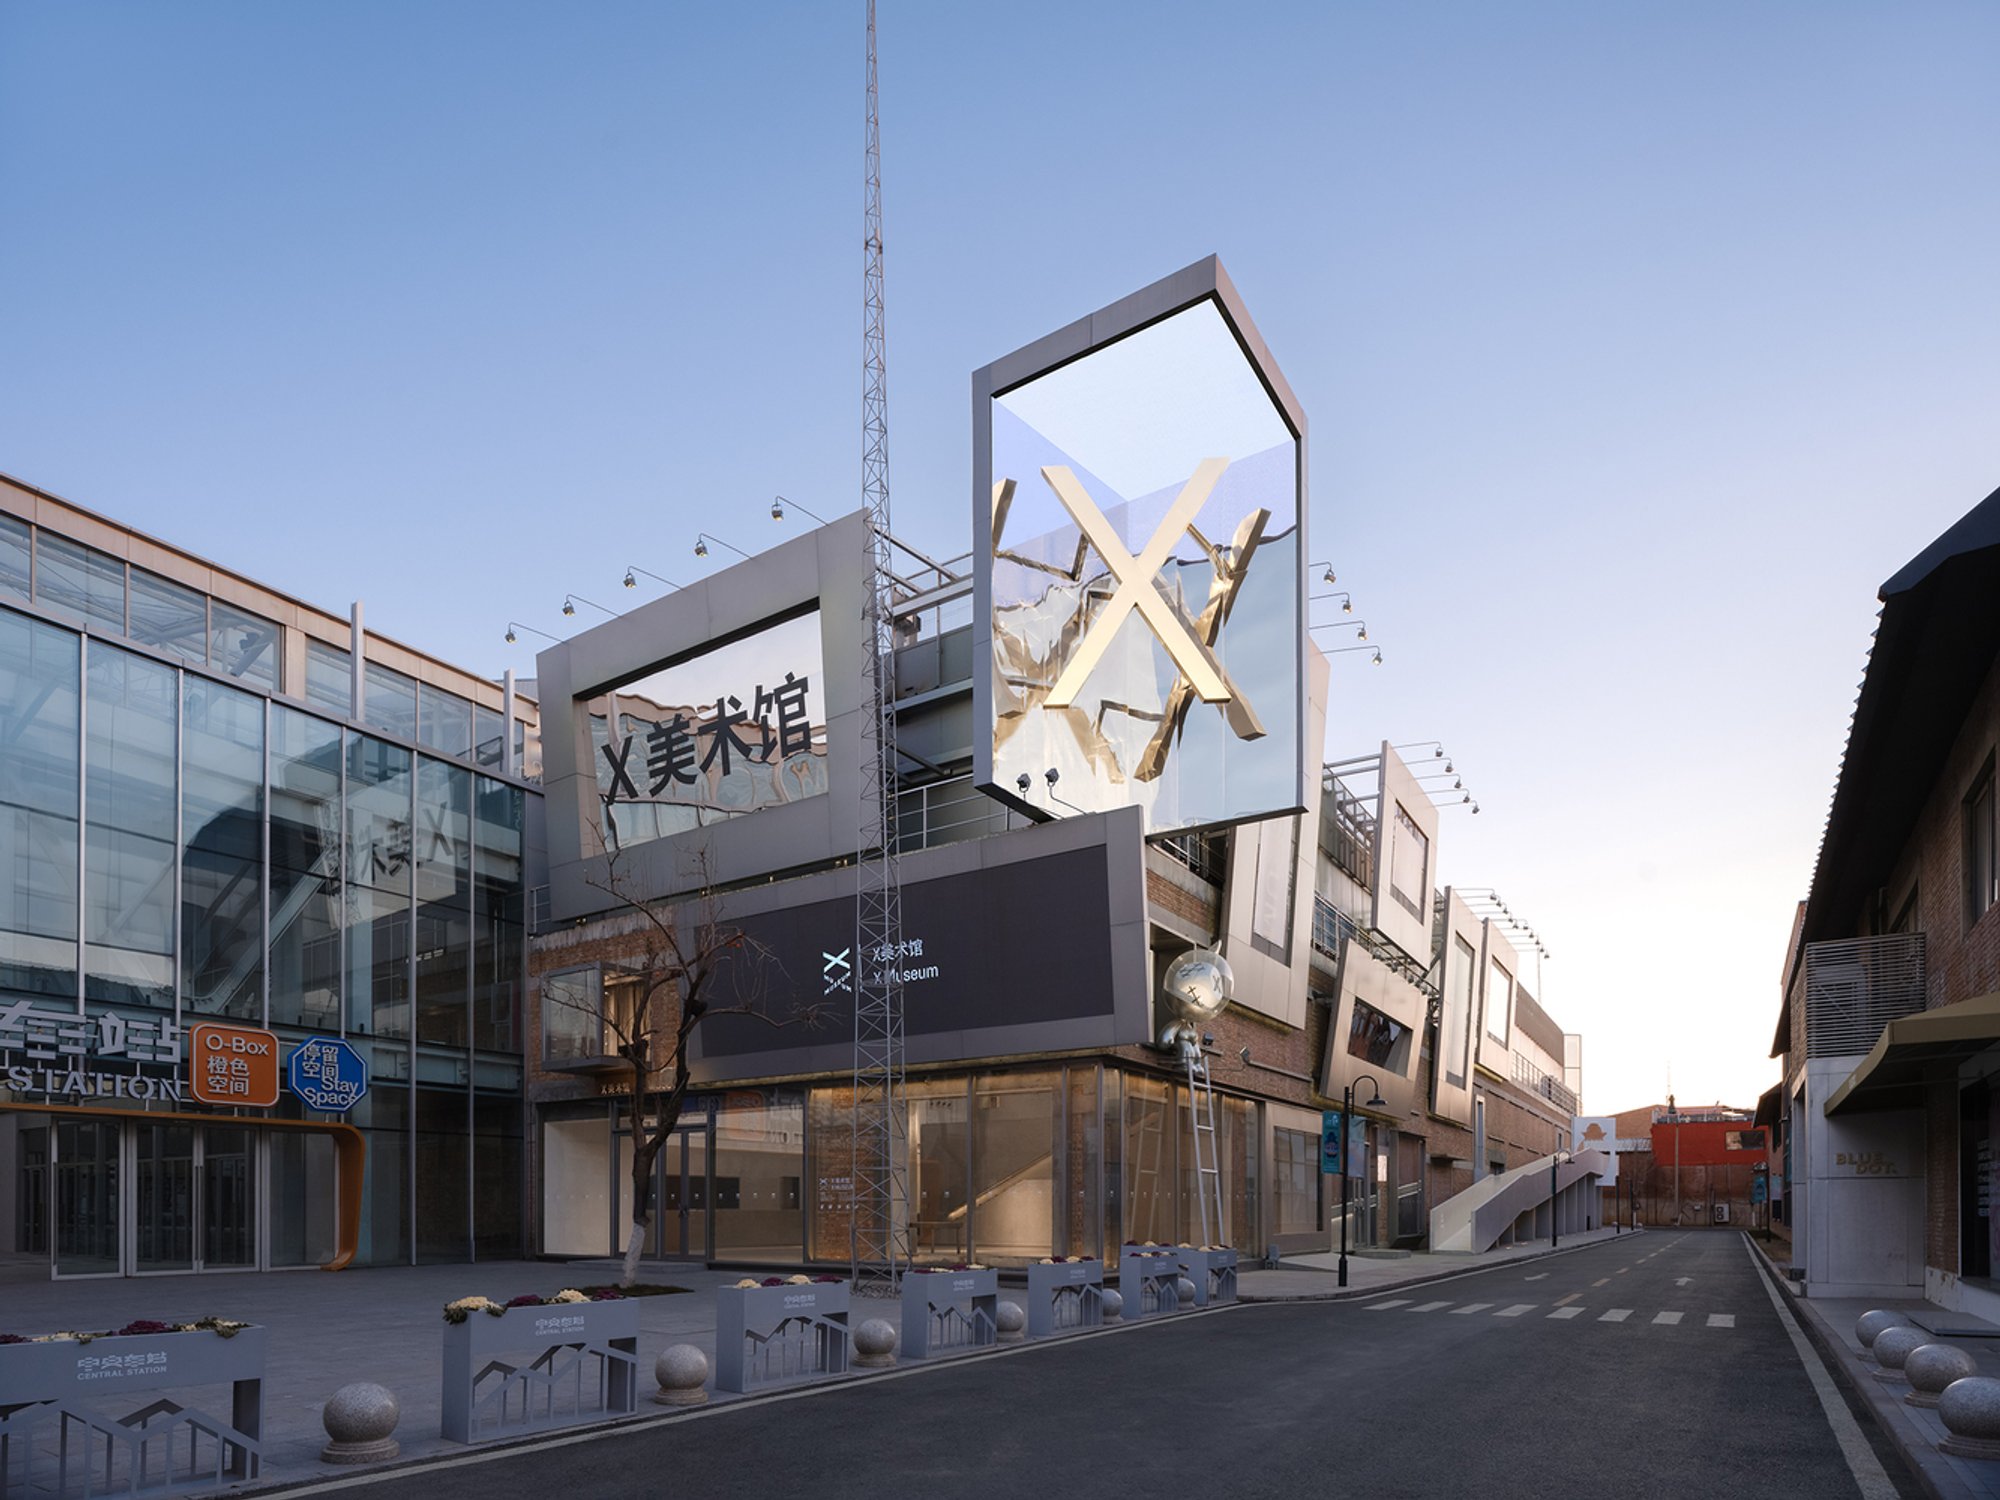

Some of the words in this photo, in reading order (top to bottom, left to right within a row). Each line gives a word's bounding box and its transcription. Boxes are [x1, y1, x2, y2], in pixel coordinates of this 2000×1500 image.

[600, 671, 811, 804] X美术馆
[205, 1033, 270, 1057] O-Box
[303, 1044, 339, 1065] 停留
[207, 1055, 250, 1077] 橙色
[302, 1061, 339, 1082] 空间
[6, 1065, 181, 1102] STATION
[207, 1075, 250, 1097] 空间
[321, 1076, 359, 1097] Stay
[303, 1086, 358, 1107] Space
[76, 1369, 124, 1380] CENTRAL
[126, 1365, 167, 1376] STATION
